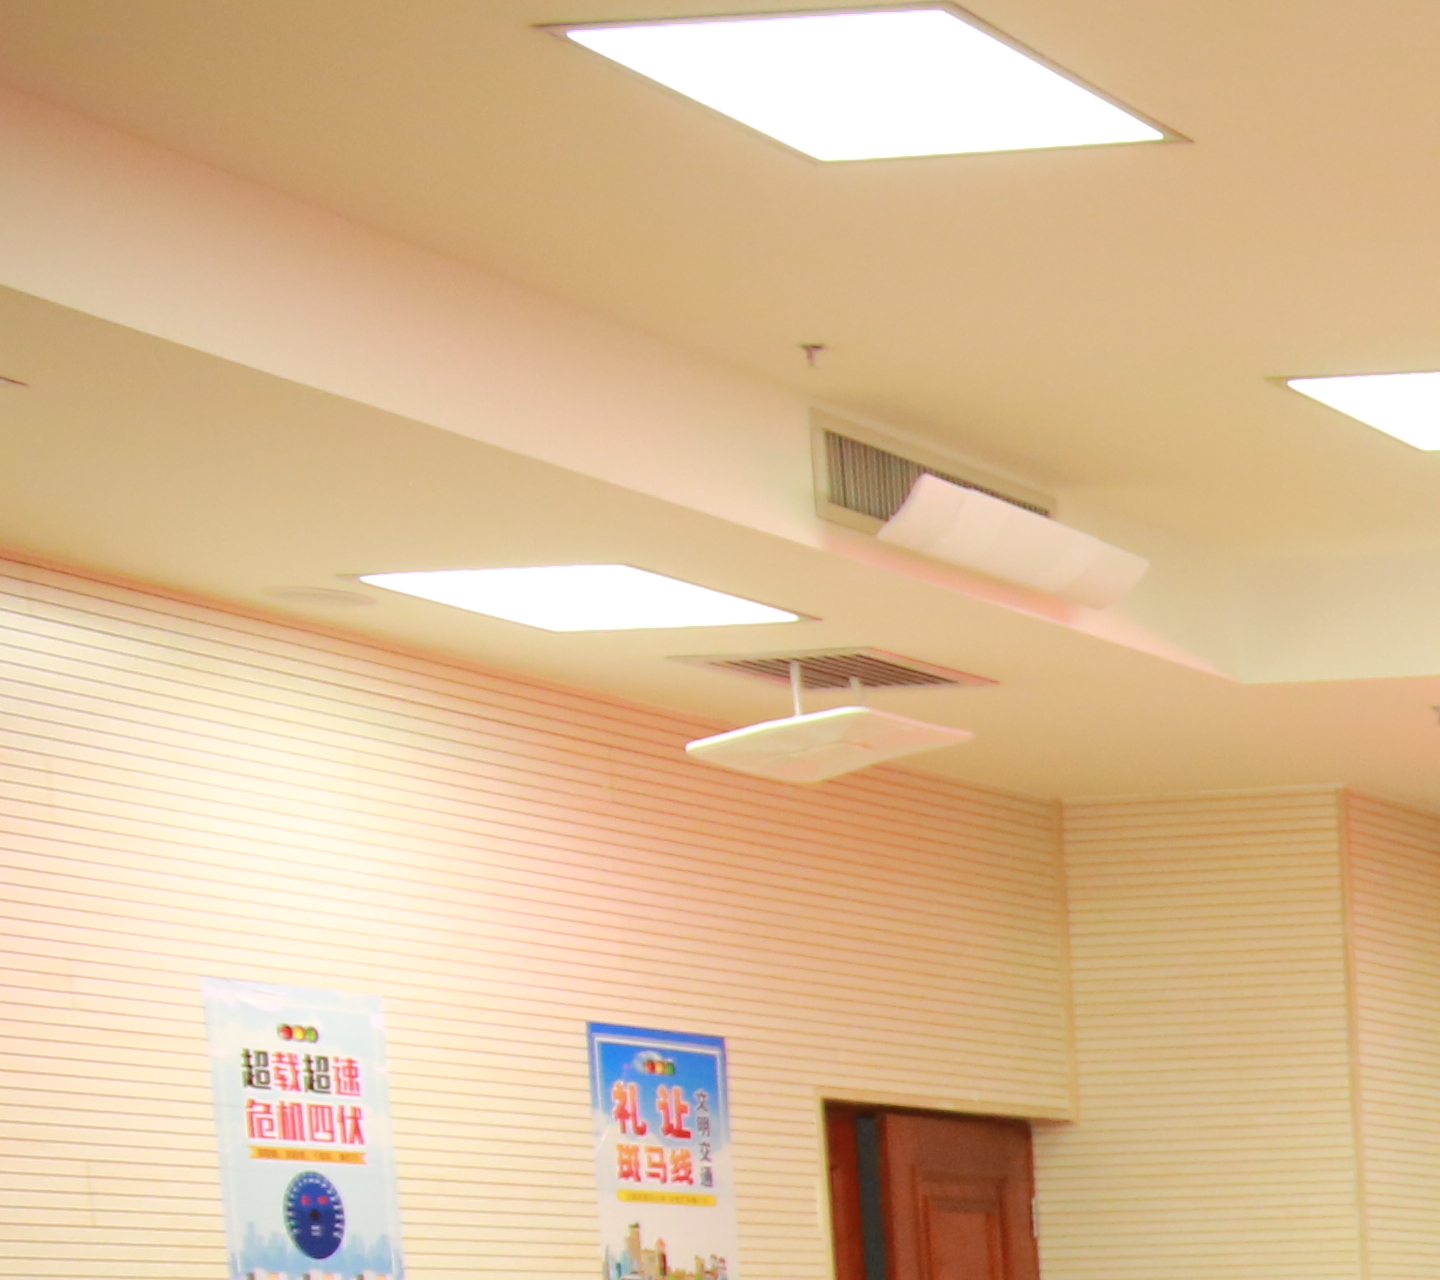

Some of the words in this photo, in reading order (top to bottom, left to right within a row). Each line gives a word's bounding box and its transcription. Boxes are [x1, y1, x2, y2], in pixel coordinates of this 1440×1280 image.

[241, 1049, 362, 1096] 超载超速
[246, 1098, 365, 1145] 危机四伏
[612, 1080, 694, 1139] 礼让
[695, 1089, 713, 1188] 文明交通
[616, 1143, 694, 1185] 斑马线
